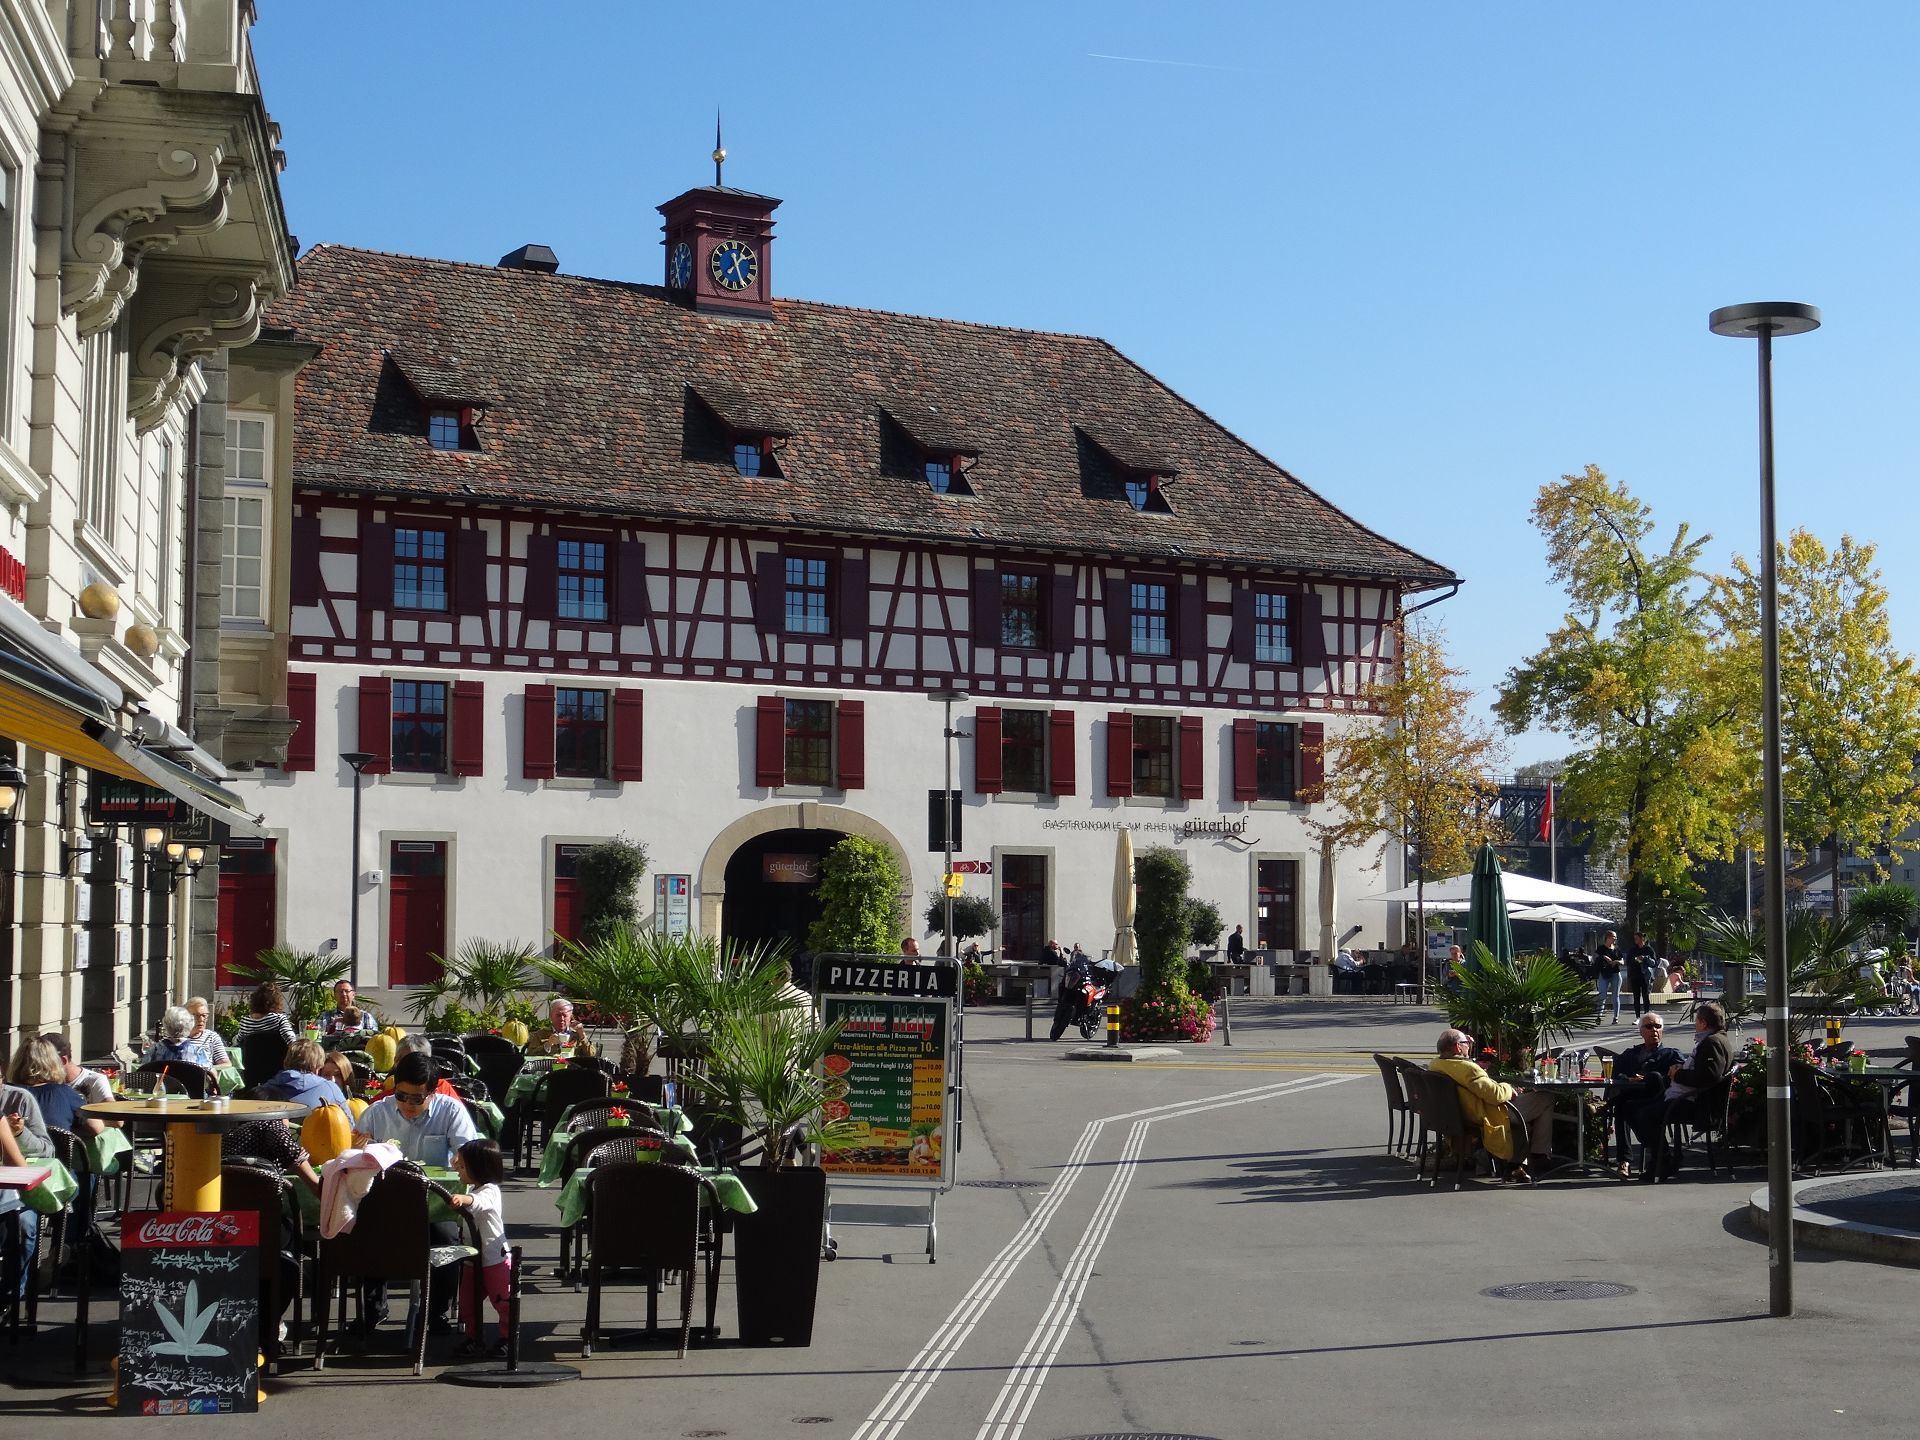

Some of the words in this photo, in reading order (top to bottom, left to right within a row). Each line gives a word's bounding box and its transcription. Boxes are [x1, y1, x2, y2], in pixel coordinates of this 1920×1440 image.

[1184, 815, 1249, 838] güterhof
[830, 967, 938, 990] PIZZERIA
[139, 1216, 217, 1243] Coca-Cola
